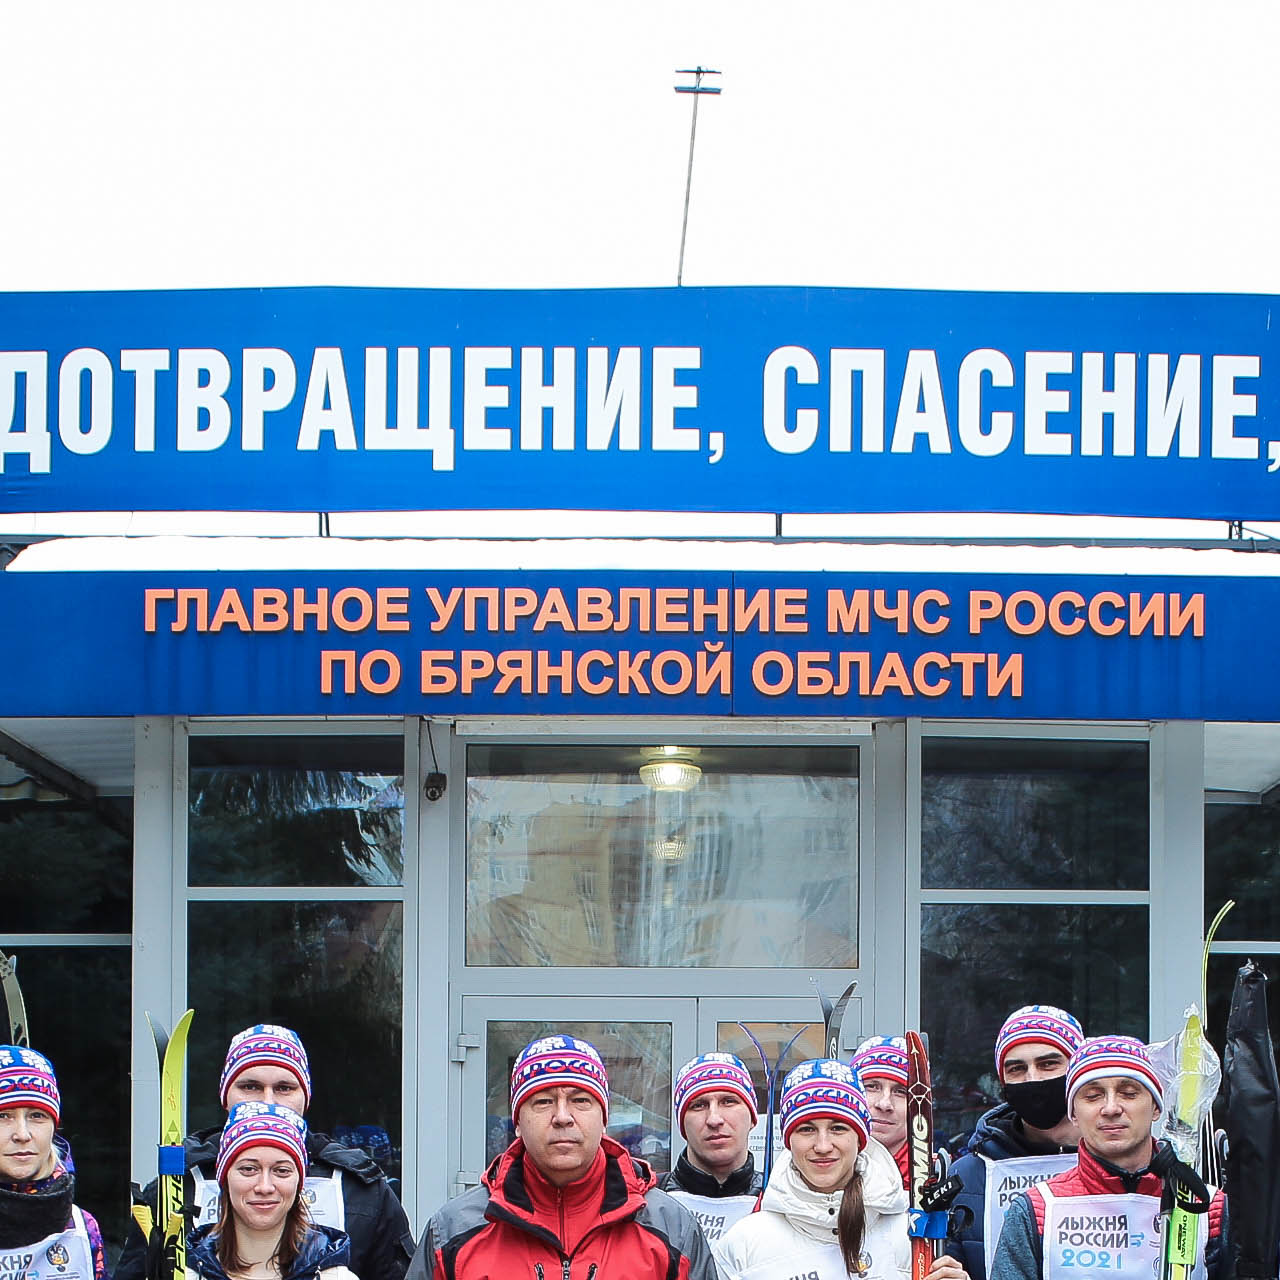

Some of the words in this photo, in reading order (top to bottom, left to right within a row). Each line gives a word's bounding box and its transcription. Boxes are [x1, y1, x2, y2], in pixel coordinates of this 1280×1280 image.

[143, 586, 412, 634] ГЛАВНОЕ
[428, 586, 811, 637] УПРАВЛЕНИЕ
[824, 588, 952, 638] МЧС
[968, 590, 1207, 639] РОССИИ
[318, 648, 403, 697] ПО
[422, 640, 734, 698] БРЯНСКОЙ
[752, 648, 1025, 700] ОБЛАСТИ
[910, 1115, 929, 1210] OMIC
[927, 1182, 954, 1205] LEKI
[171, 1174, 184, 1274] FIHE
[695, 1211, 726, 1228] ЖНЯ
[1057, 1215, 1127, 1231] ЛЫЖНЯ
[1059, 1232, 1129, 1248] РОССИИ
[1060, 1249, 1122, 1269] 2021
